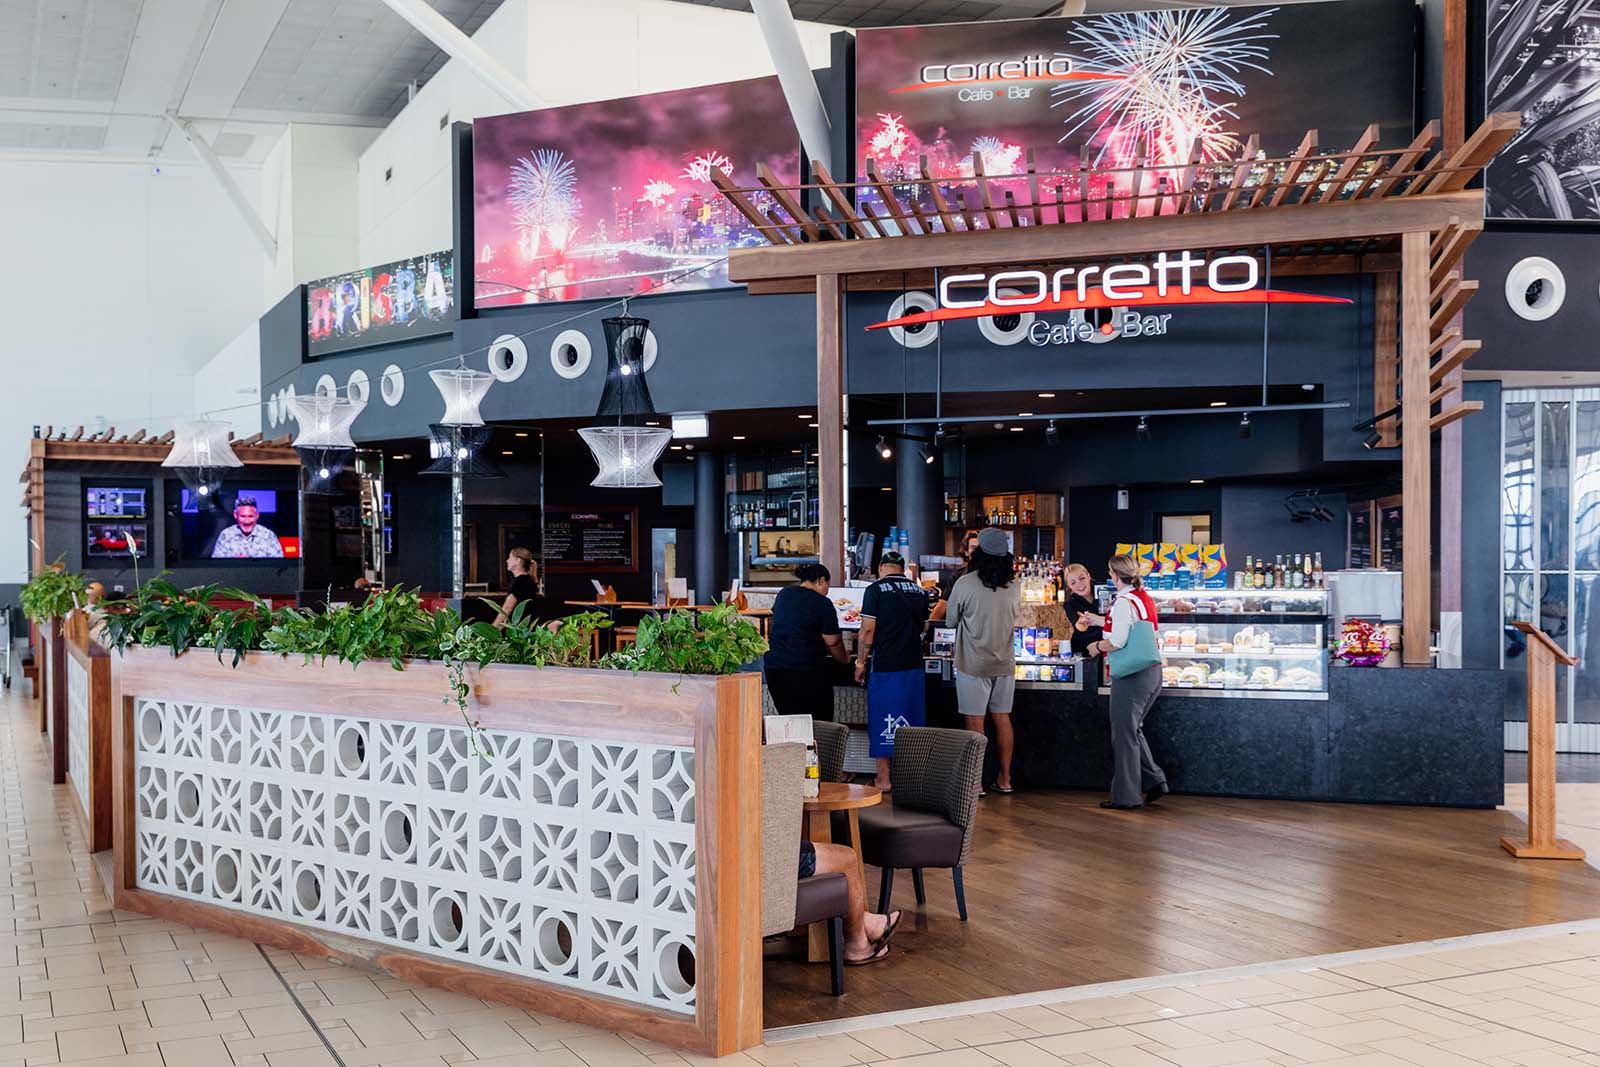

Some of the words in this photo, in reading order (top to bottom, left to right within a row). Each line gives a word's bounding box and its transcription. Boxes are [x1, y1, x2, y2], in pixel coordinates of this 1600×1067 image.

[921, 54, 1073, 84] corretto
[957, 86, 993, 102] Cafe
[1007, 85, 1033, 99] Bar
[939, 250, 1259, 309] corretto
[1028, 317, 1094, 347] Cafe
[1120, 311, 1172, 339] Bar
